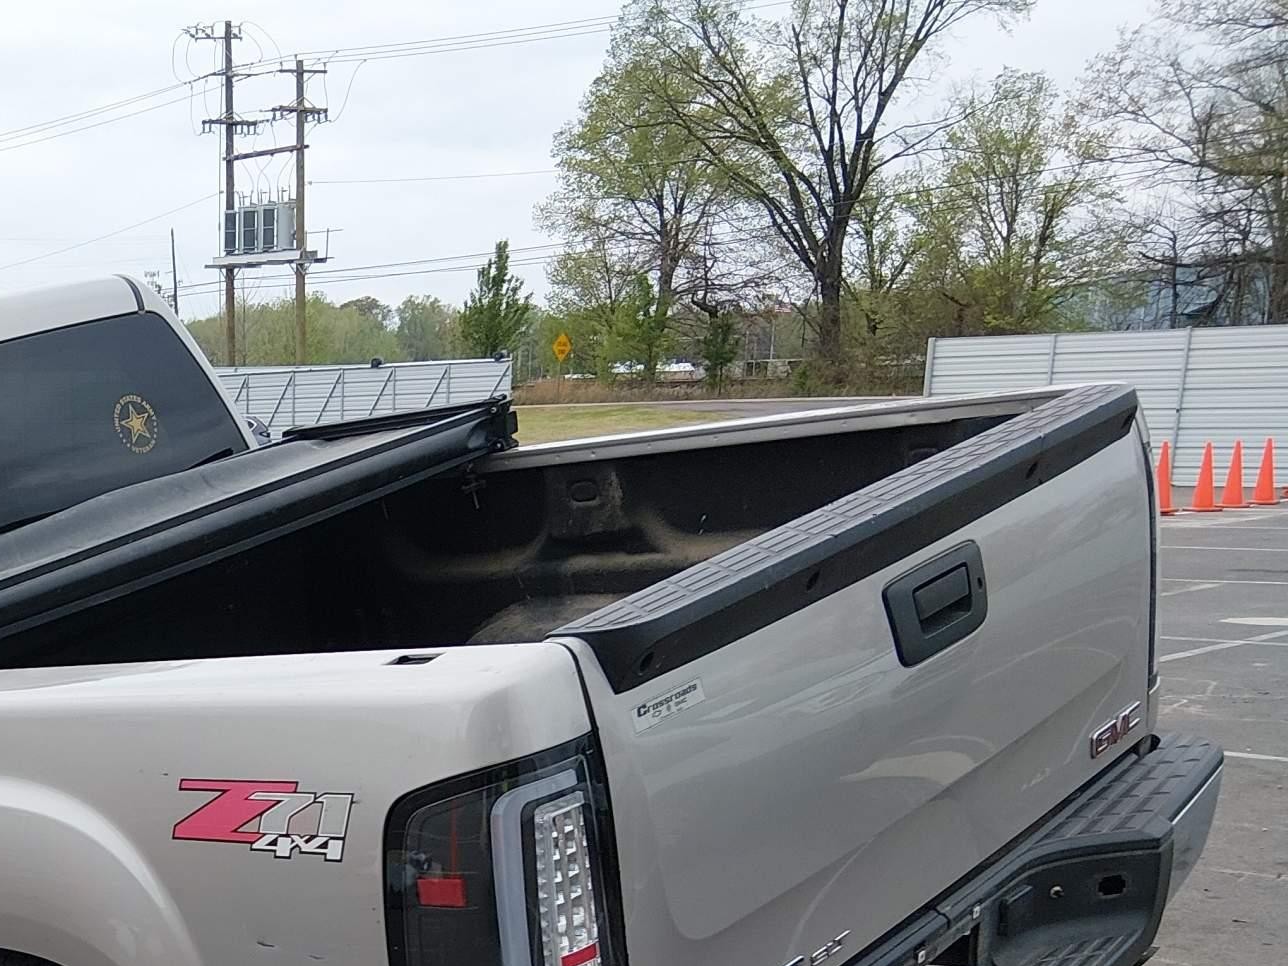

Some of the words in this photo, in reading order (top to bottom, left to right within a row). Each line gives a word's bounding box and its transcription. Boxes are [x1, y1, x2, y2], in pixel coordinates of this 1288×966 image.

[637, 683, 697, 718] Crossroads
[1090, 700, 1141, 759] GMC
[172, 778, 355, 844] Z71
